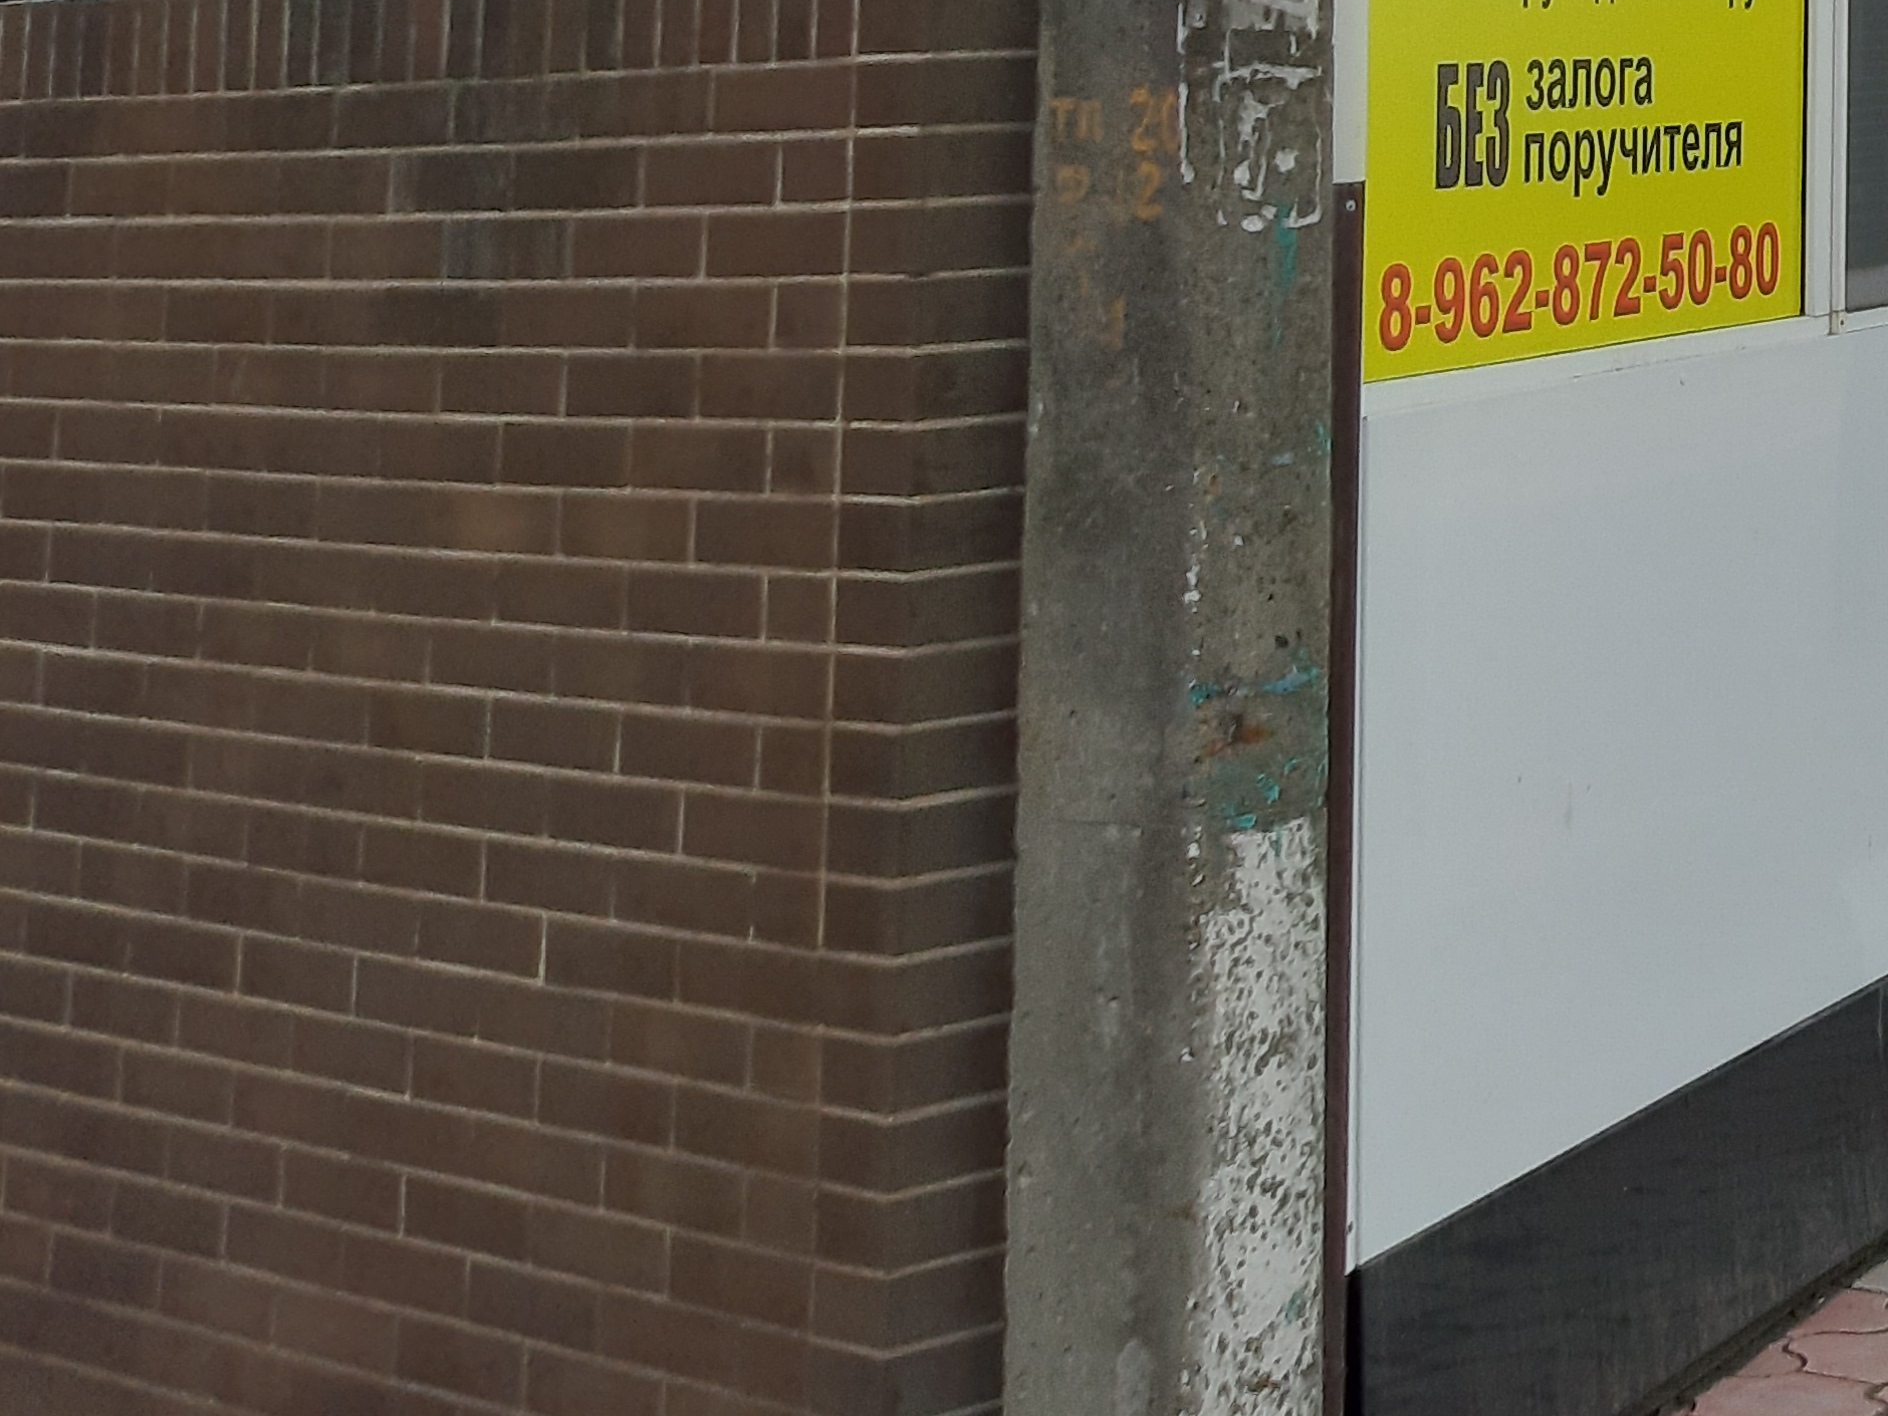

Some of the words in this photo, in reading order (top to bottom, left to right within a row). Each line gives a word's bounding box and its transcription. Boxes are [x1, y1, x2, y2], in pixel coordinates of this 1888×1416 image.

[1435, 60, 1510, 190] БЕЗ
[1525, 57, 1653, 111] залога
[1523, 121, 1743, 197] поручителя
[1379, 221, 1780, 352] 8-962-872-50-80
